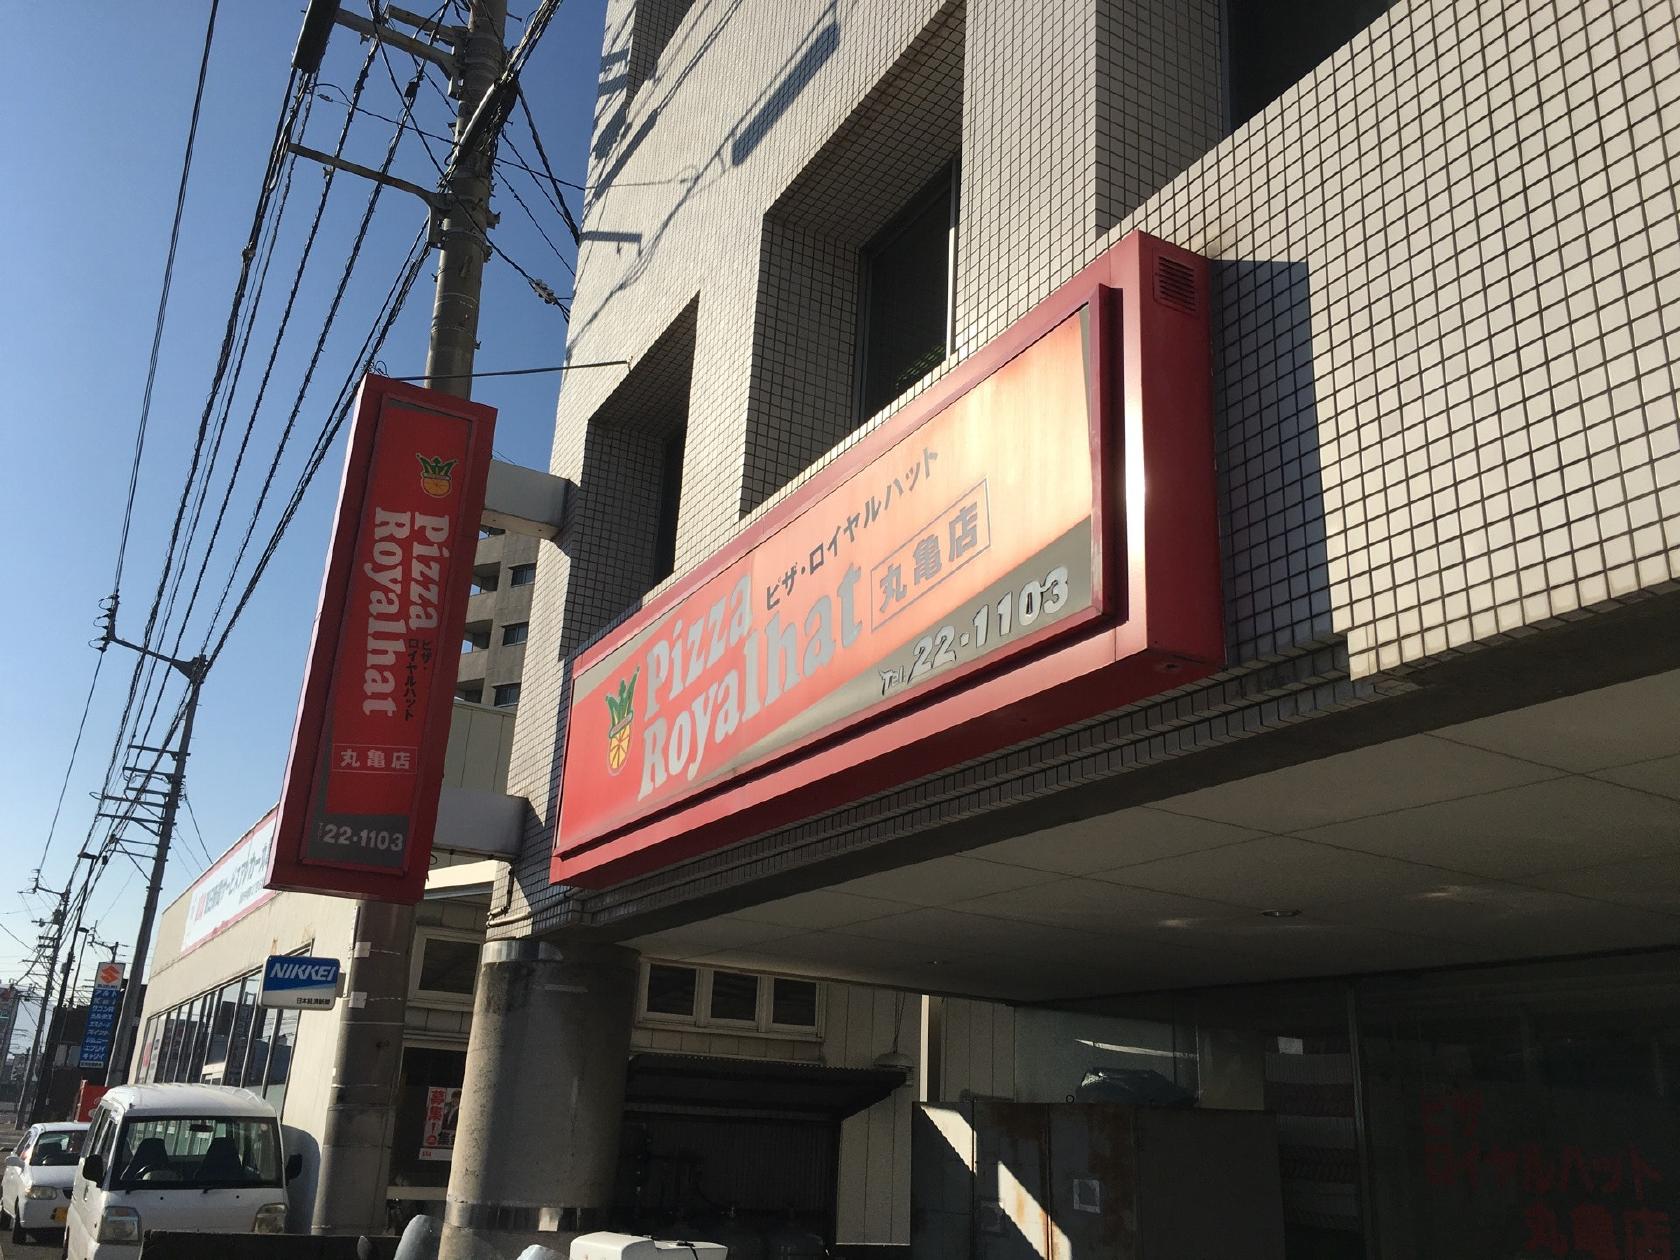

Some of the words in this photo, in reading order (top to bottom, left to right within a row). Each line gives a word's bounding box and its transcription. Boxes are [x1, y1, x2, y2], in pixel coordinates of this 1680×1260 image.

[408, 511, 450, 630] Pizza
[766, 447, 938, 611] ピザ・ロイヤルハット
[879, 501, 979, 613] 丸亀店
[363, 507, 412, 717] Royalhat
[645, 573, 752, 720] Pizza
[401, 638, 418, 721] ロイヤルハット
[638, 563, 863, 800] Royalhat
[339, 748, 411, 769] 丸亀店
[269, 962, 337, 981] NIKKEI
